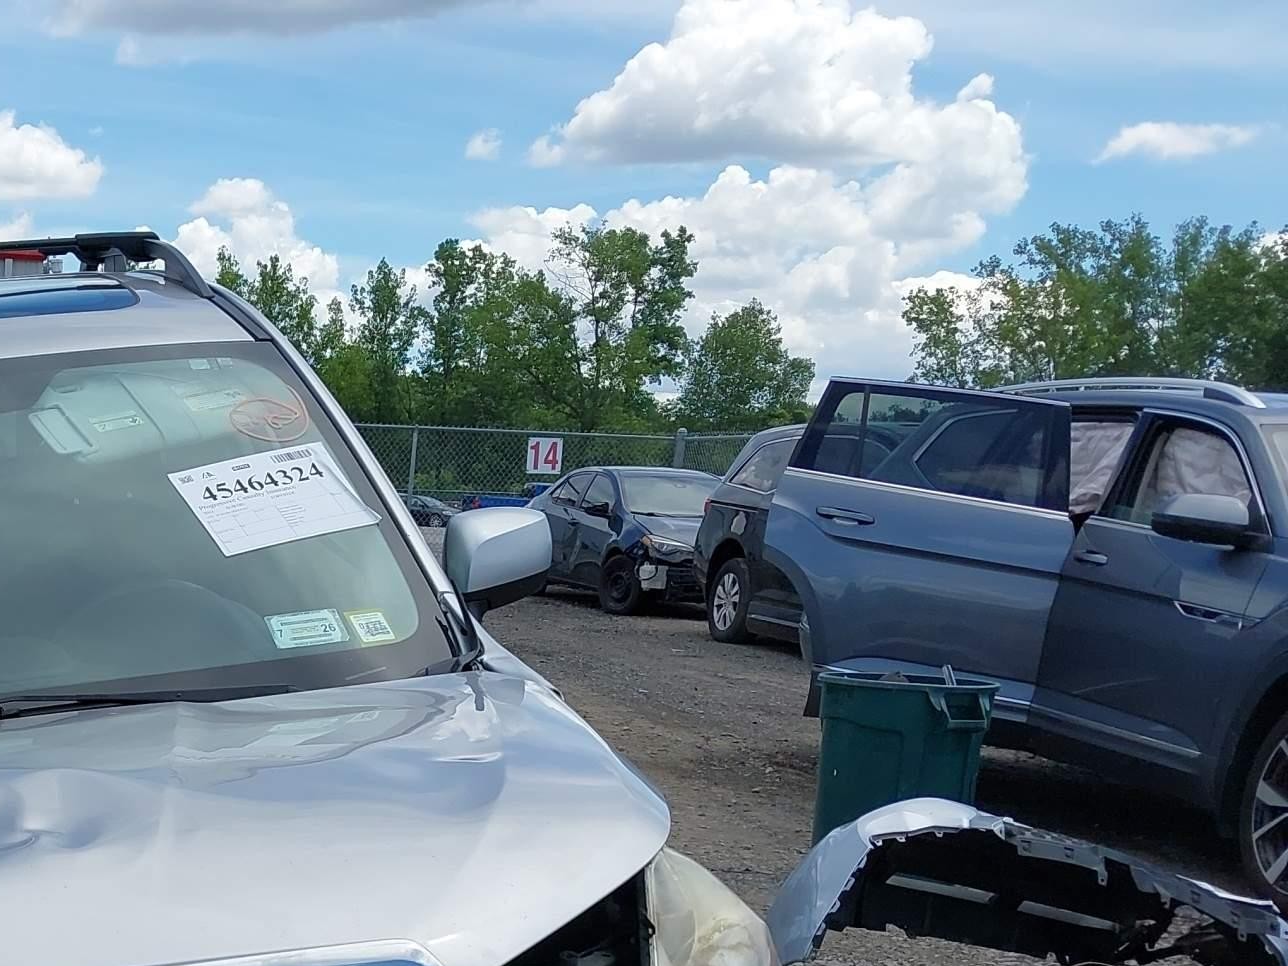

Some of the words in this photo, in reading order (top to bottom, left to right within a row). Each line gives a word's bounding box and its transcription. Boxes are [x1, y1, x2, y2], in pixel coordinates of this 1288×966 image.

[530, 441, 559, 470] 14
[203, 462, 324, 501] 45464324
[320, 623, 336, 633] 26
